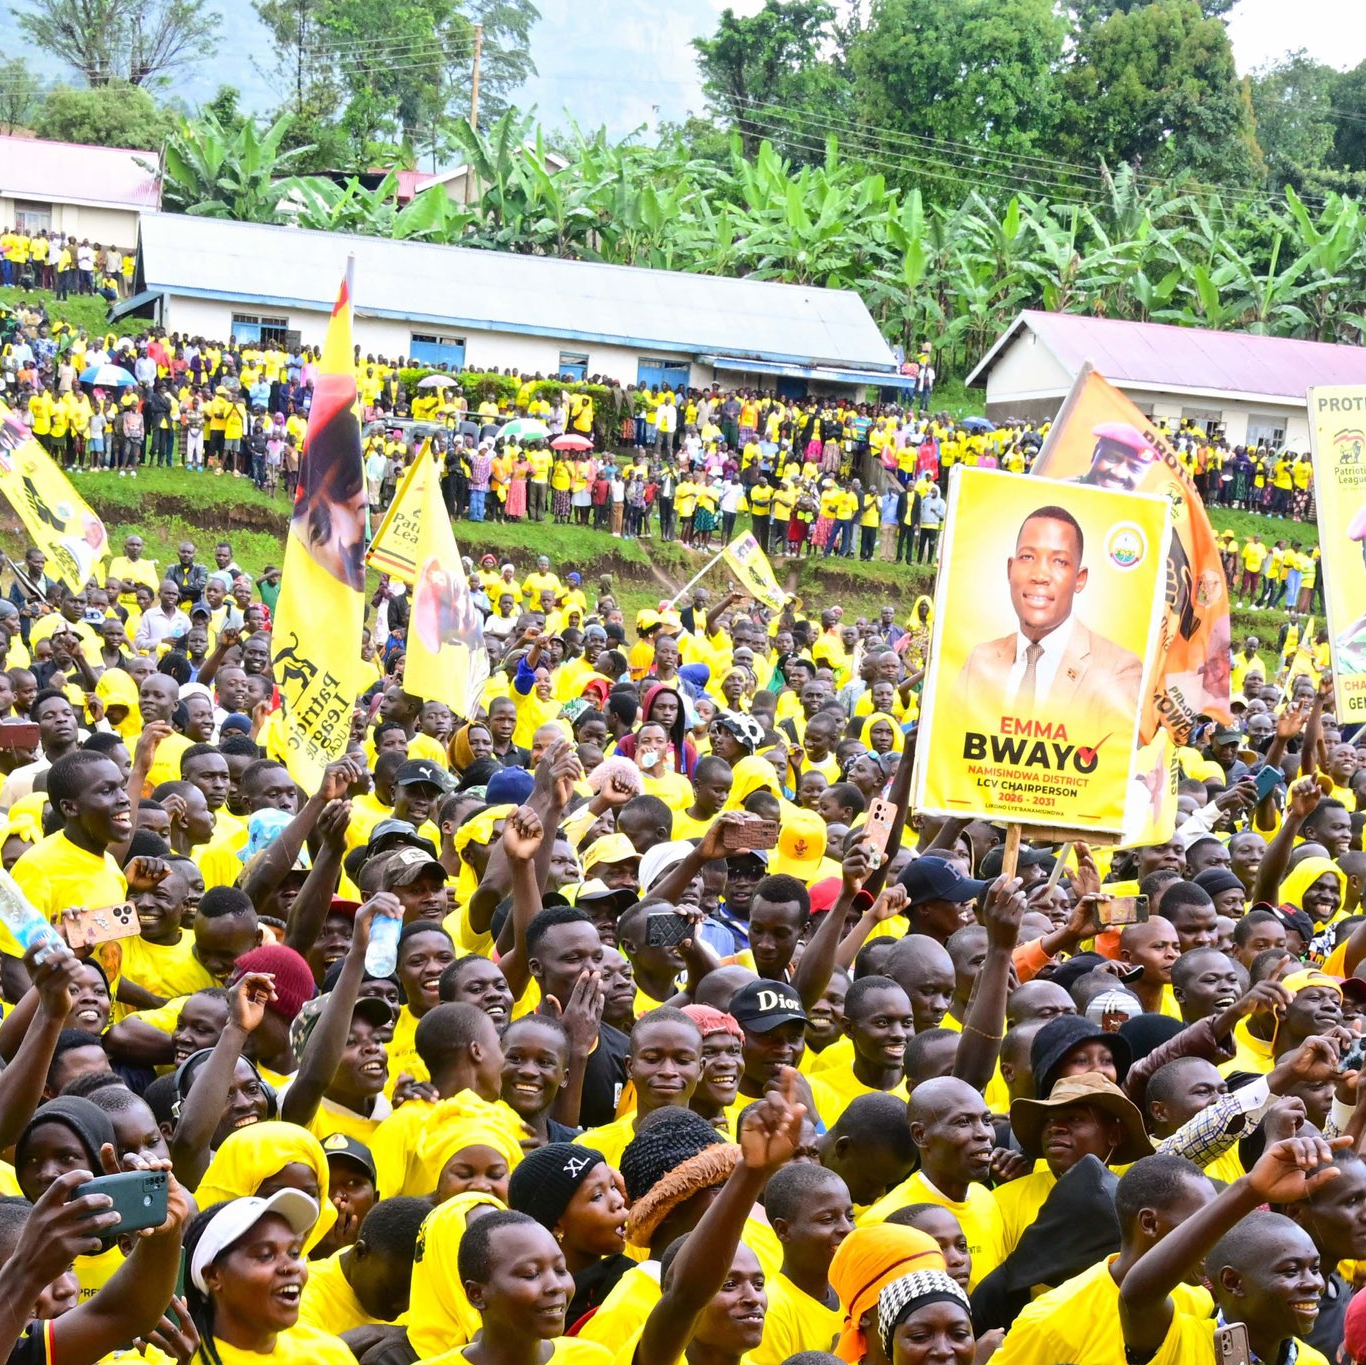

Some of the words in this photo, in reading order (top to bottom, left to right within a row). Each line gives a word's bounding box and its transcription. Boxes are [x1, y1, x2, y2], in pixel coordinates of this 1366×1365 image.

[1000, 716, 1068, 742] EMMA
[963, 732, 1099, 774] BWAYO
[968, 765, 1040, 782] NAMISINDWA
[1043, 774, 1089, 788] DISTRICT
[977, 778, 999, 789] LCV
[1001, 780, 1078, 798] CHAIRPERSON
[998, 792, 1024, 804] 2026
[1032, 795, 1056, 807] 2031
[756, 989, 800, 1011] Dior
[563, 1157, 590, 1178] XL
